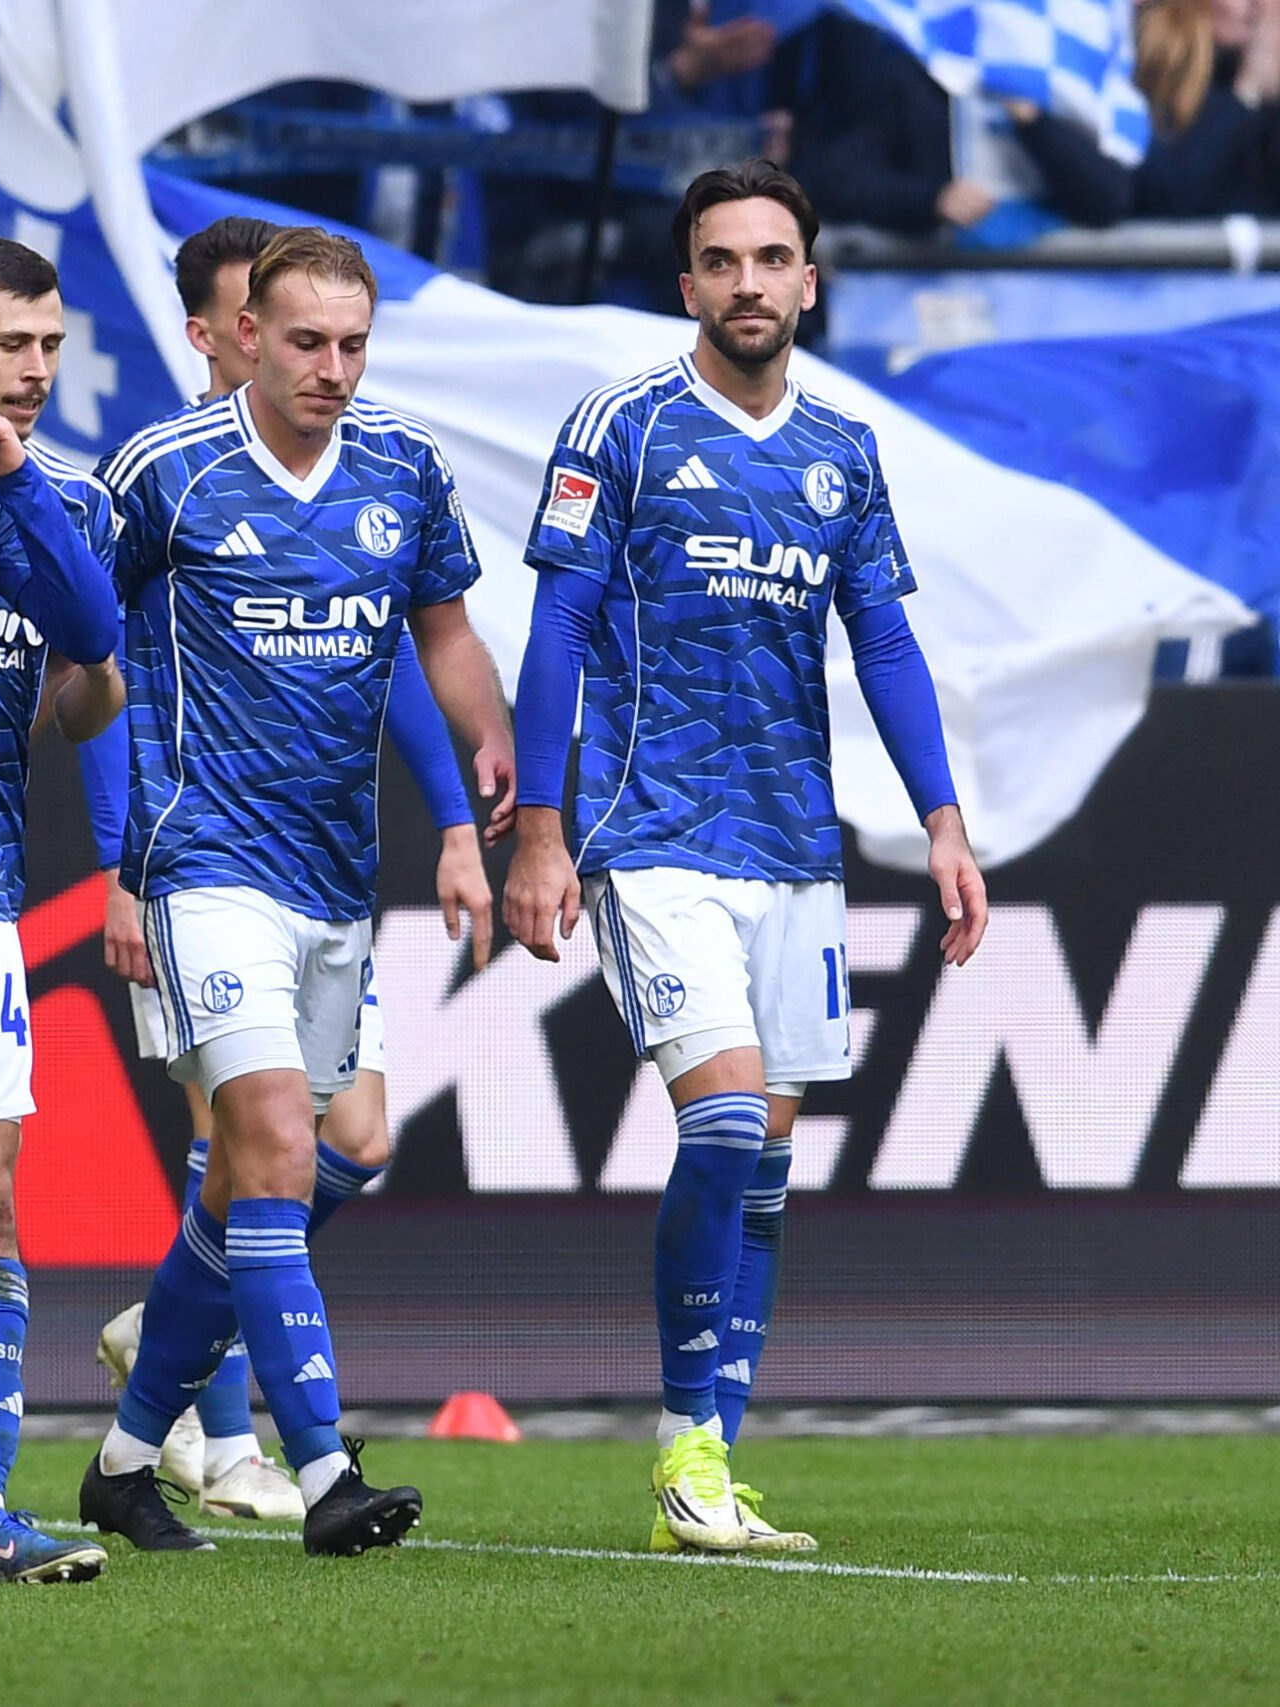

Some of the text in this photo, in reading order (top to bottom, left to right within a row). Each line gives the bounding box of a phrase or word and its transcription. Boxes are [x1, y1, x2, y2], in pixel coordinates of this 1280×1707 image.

[685, 535, 830, 586] SUN
[706, 575, 809, 610] MINIMEAL
[232, 595, 391, 630] SUN
[1, 973, 27, 1047] 4
[683, 1291, 720, 1306] S04
[281, 1312, 323, 1327] S04
